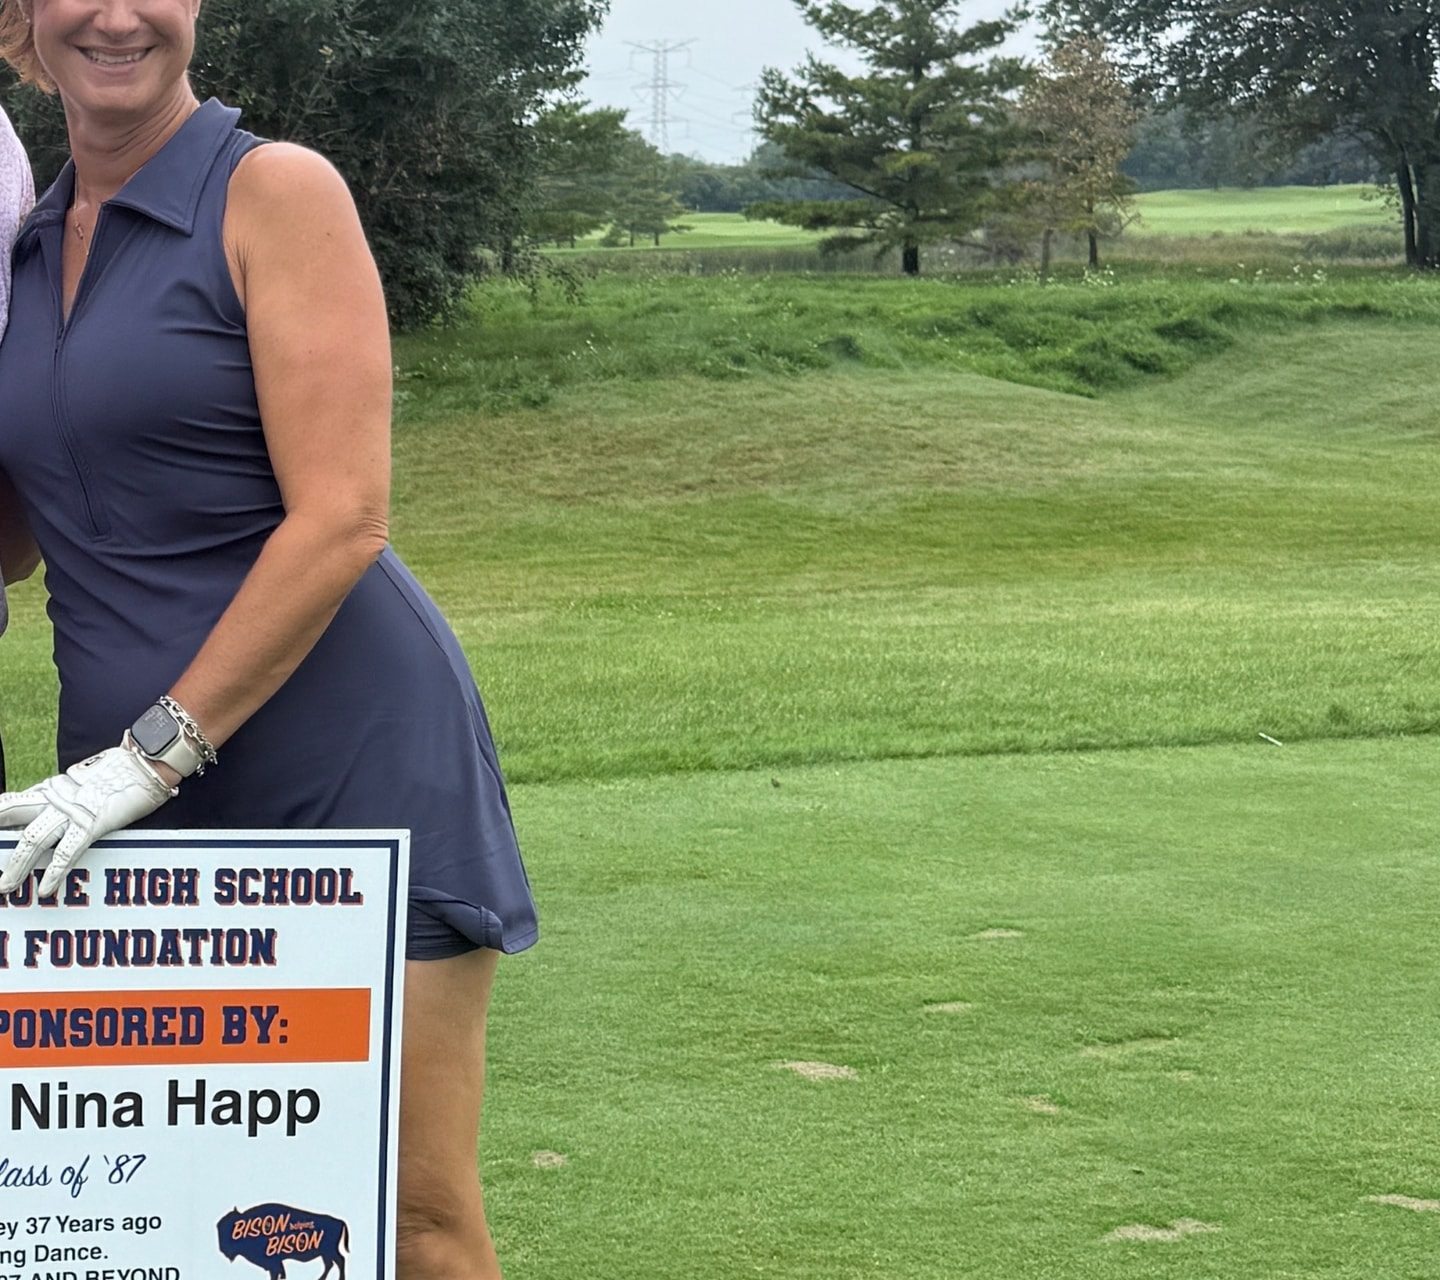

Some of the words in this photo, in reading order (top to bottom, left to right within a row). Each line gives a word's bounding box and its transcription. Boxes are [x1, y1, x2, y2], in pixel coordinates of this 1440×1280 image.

[104, 868, 200, 906] HIGH
[214, 868, 363, 905] SCHOOL
[24, 928, 277, 968] FOUNDATION
[222, 1006, 288, 1044] BY:
[12, 1082, 144, 1130] Nina
[168, 1079, 320, 1137] Happ
[60, 1155, 90, 1198] of
[26, 1217, 50, 1234] 37
[56, 1215, 114, 1233] Years
[122, 1216, 161, 1234] ago
[231, 1213, 290, 1240] BISON
[265, 1230, 324, 1257] BISON
[35, 1245, 108, 1262] Dance.
